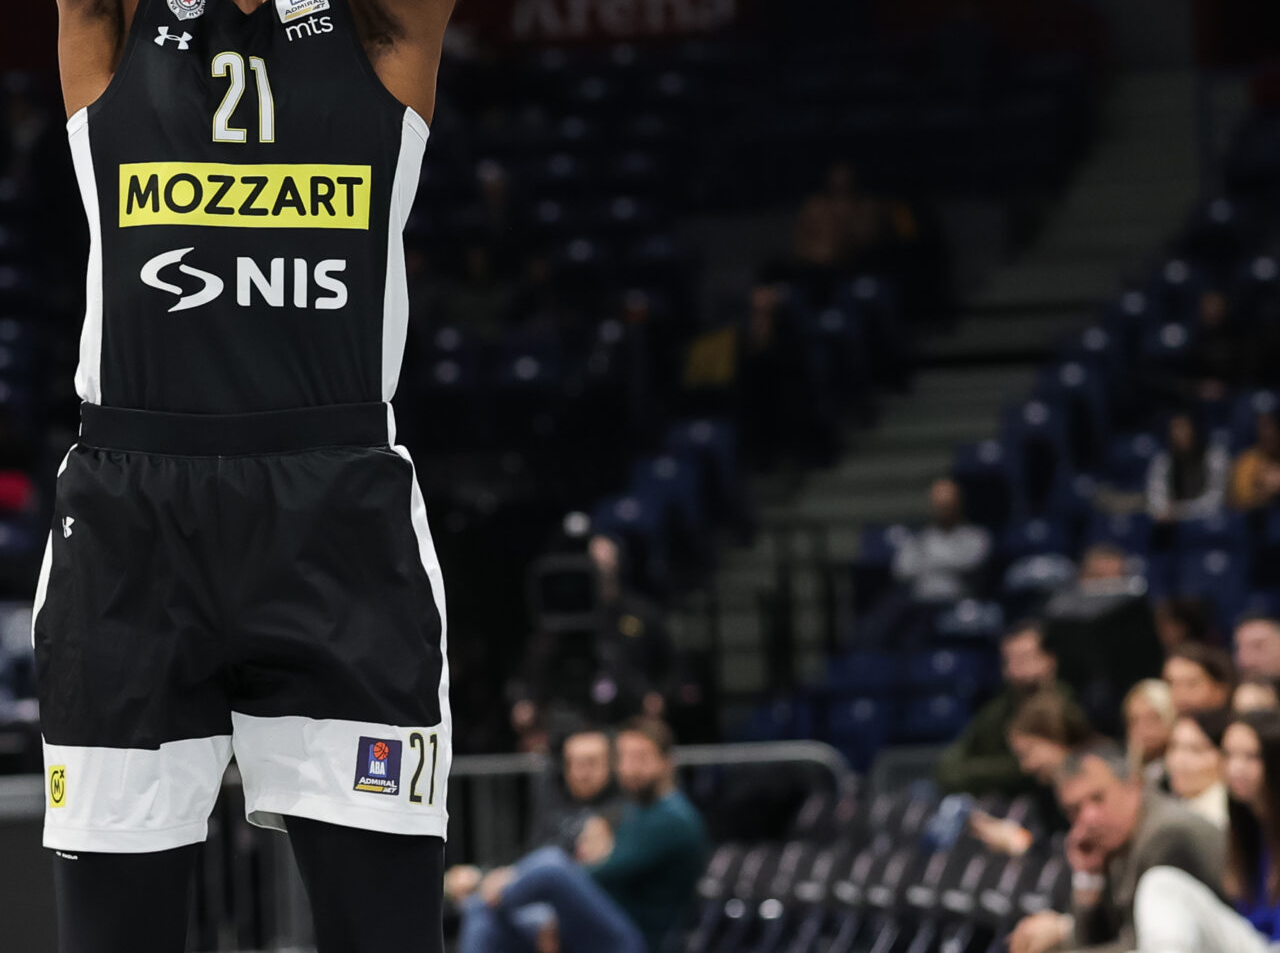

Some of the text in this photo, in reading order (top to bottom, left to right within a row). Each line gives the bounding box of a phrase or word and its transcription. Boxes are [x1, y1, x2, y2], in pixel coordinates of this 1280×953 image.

[285, 16, 334, 42] mts
[211, 50, 276, 144] 21
[126, 173, 363, 217] MOZZART
[236, 256, 348, 310] NIS
[358, 776, 398, 788] ADMIRAL
[369, 759, 386, 776] ABA
[408, 730, 438, 806] 21
